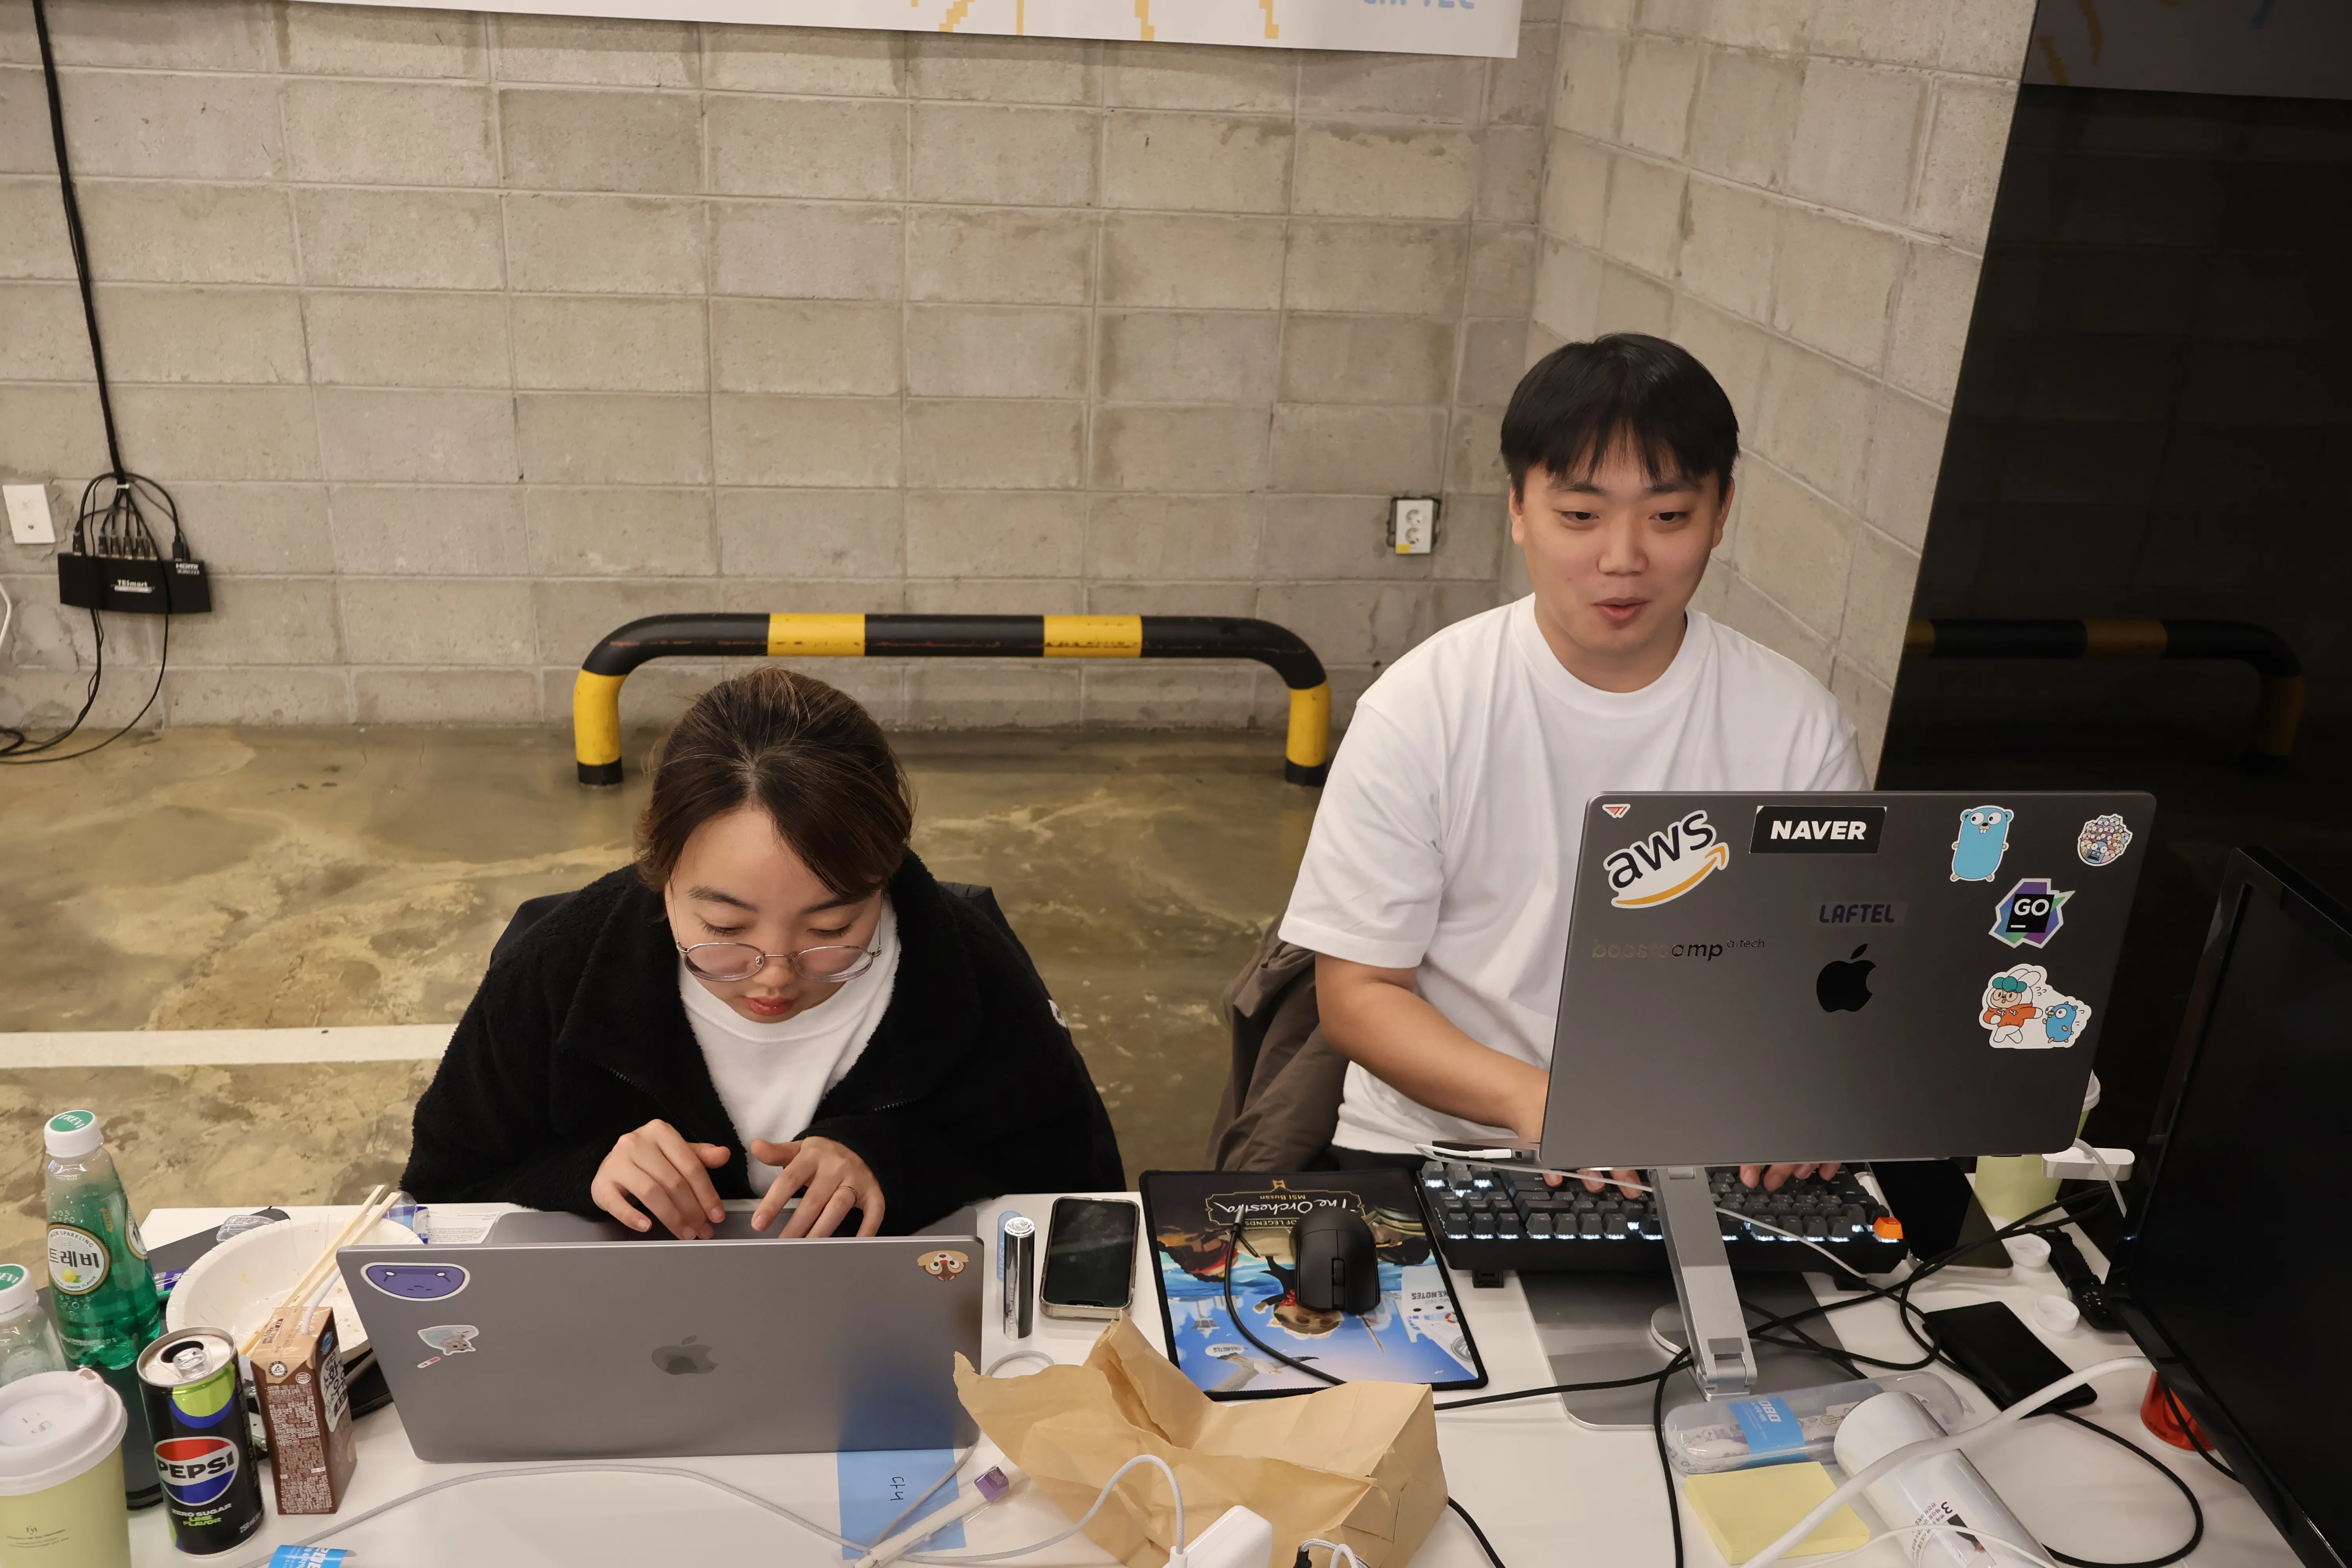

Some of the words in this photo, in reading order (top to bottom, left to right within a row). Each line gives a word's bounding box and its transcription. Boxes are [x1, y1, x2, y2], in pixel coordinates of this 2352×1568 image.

[1771, 821, 1866, 840] NAVER
[1607, 813, 1713, 888] aws
[1819, 904, 1894, 923] LAFTEL
[2014, 898, 2049, 916] GO
[58, 1114, 85, 1129] TREVI
[60, 1230, 94, 1248] SPARKLING
[49, 1247, 100, 1268] 트레비
[0, 1272, 19, 1284] EVI
[156, 1450, 234, 1479] PEPSI
[172, 1508, 195, 1517] ZERO
[196, 1503, 232, 1517] SUGAR
[1941, 1501, 1953, 1514] 3
[183, 1517, 221, 1526] FLAVOR
